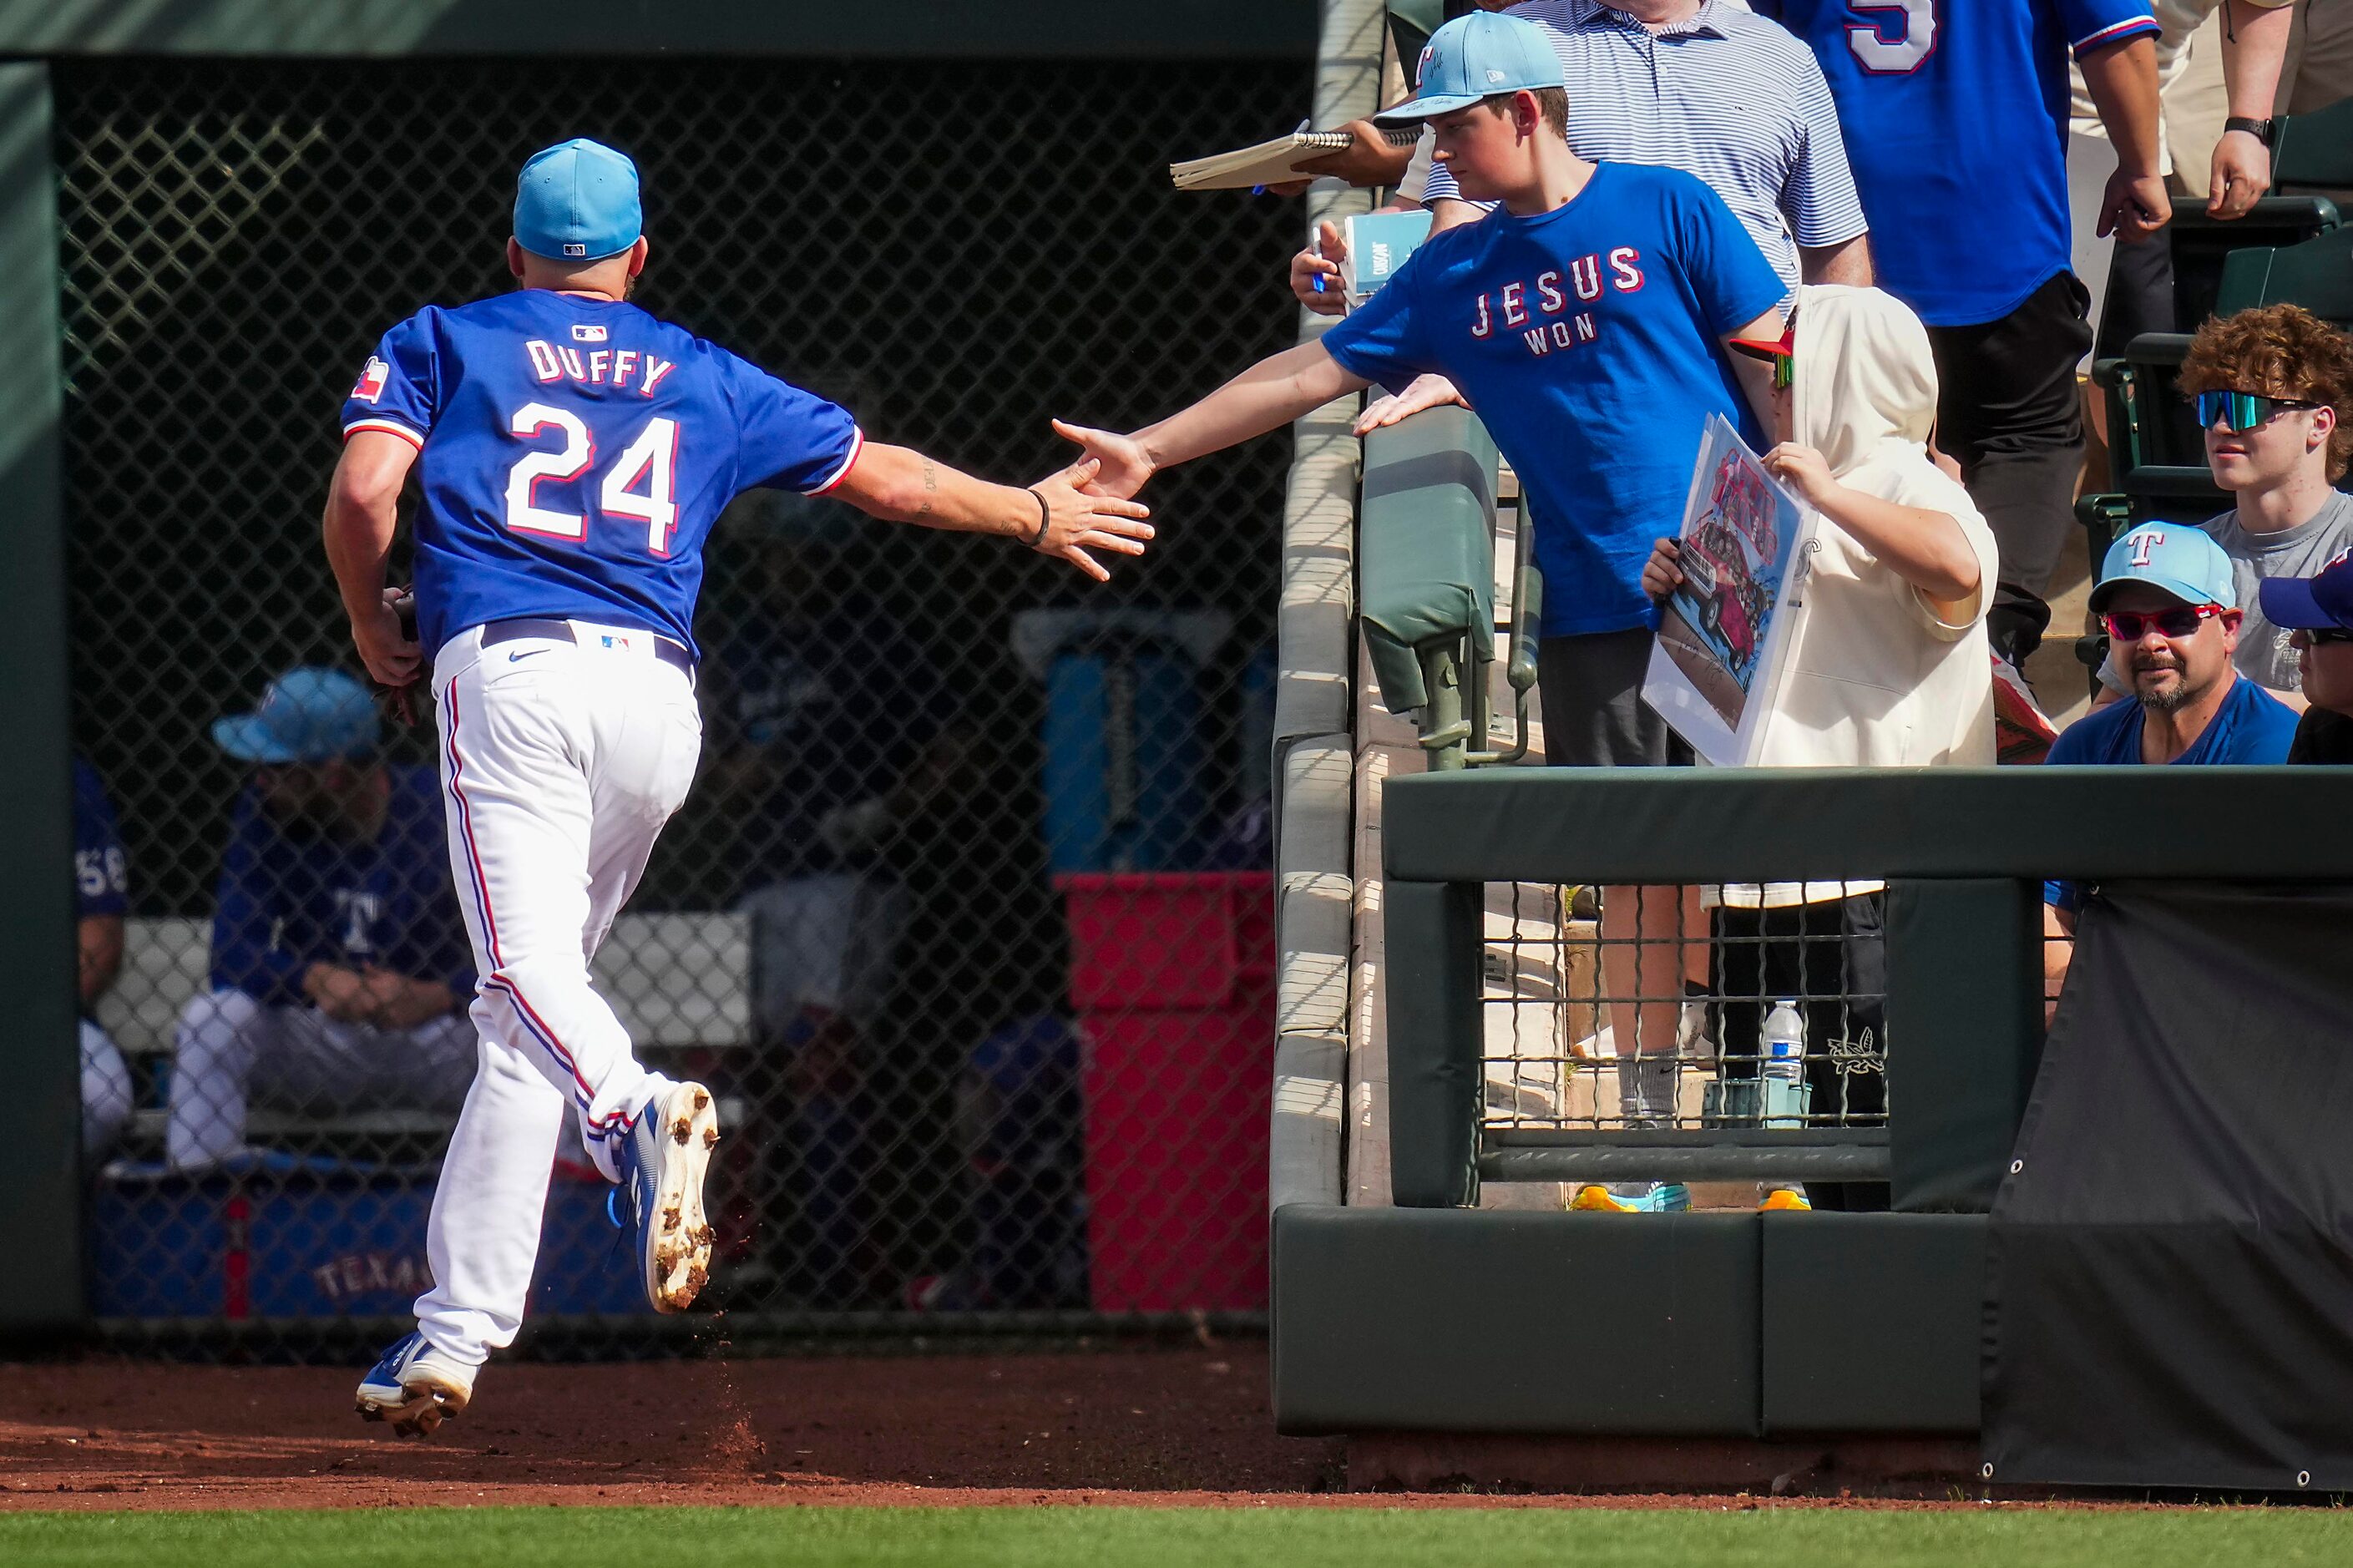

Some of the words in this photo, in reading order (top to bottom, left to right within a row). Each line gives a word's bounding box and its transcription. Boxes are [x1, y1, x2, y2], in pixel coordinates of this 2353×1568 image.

[1471, 245, 1645, 339] JESUS
[1523, 312, 1596, 357] WON
[524, 339, 677, 399] DUFFY
[503, 402, 681, 559] 24
[2128, 531, 2165, 568] T
